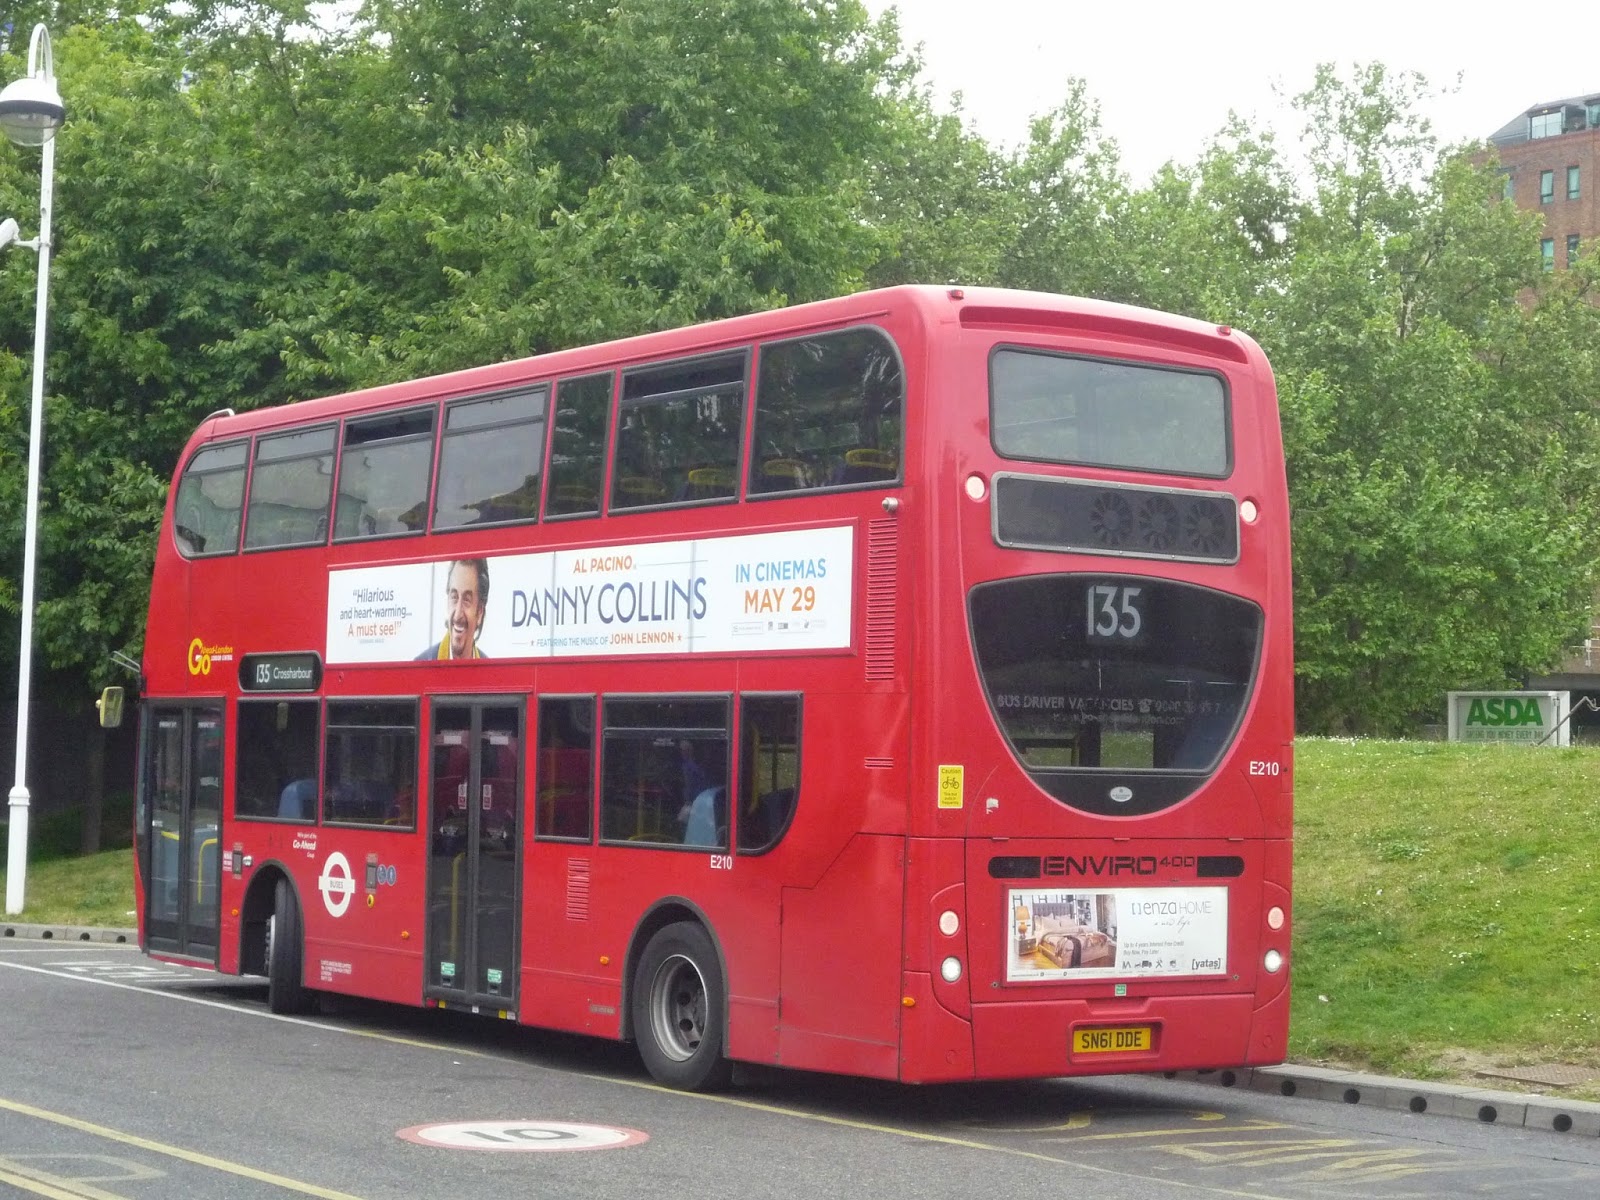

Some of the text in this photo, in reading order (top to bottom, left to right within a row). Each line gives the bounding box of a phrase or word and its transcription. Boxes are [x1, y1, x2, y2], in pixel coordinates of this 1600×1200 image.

[573, 555, 633, 573] AL PACINO
[735, 558, 827, 583] IN CINEMAS
[511, 576, 707, 628] DANNY COLLINS
[744, 586, 816, 614] MAY 29
[340, 607, 352, 620] and
[1087, 584, 1142, 638] 135
[347, 623, 355, 637] A
[356, 623, 377, 637] must
[536, 631, 675, 648] FEATURING THE MUSIC OF JOHN LENNON
[187, 637, 211, 676] Go
[256, 663, 313, 683] 135 Crossharbour
[997, 694, 1020, 708] BUS
[1023, 695, 1064, 709] DRIVER
[1466, 698, 1544, 726] ASDA
[1249, 760, 1280, 776] E210
[710, 854, 733, 870] E210
[1042, 855, 1195, 877] ENVIRO 400
[329, 880, 344, 889] BUSES
[1143, 901, 1212, 915] enza HOME
[1081, 1031, 1142, 1049] SN61 DDE
[462, 1127, 579, 1144] 10
